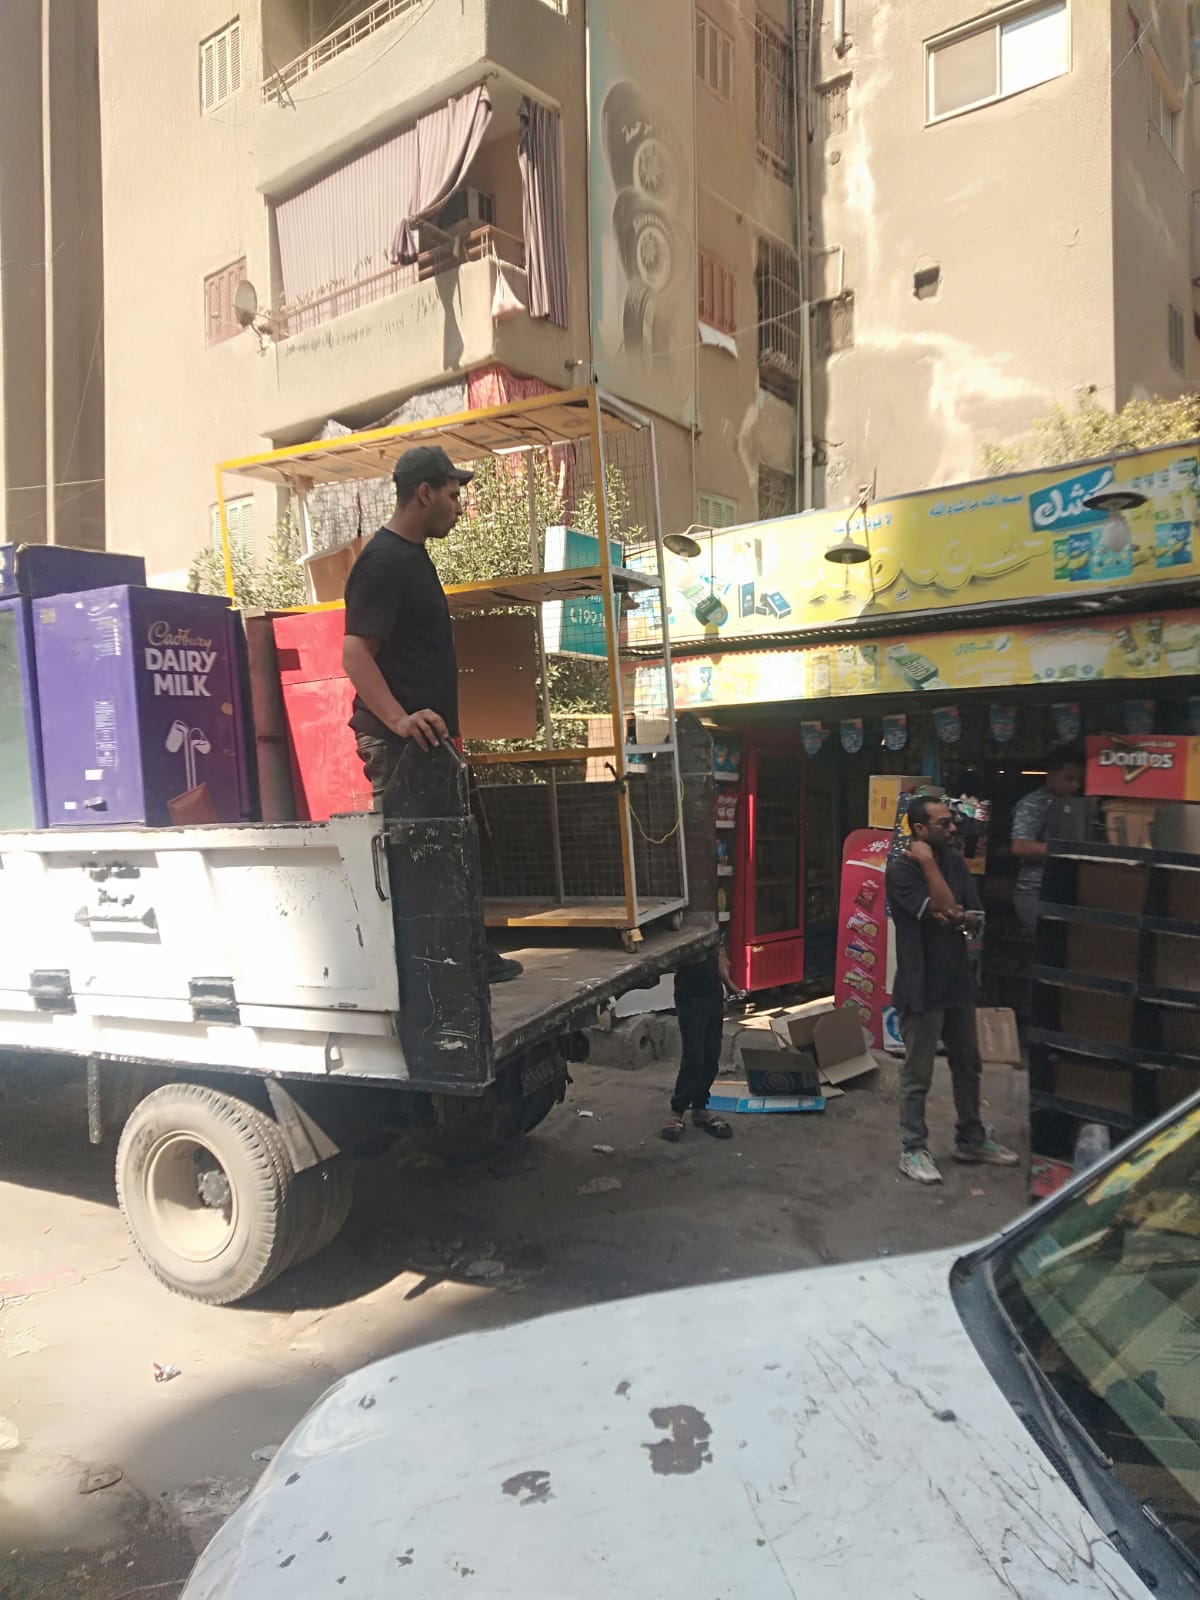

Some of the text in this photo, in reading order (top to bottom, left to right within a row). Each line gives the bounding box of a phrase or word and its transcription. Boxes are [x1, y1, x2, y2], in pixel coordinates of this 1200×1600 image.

[147, 620, 213, 653] Cadbury
[144, 647, 217, 673] DAIRY
[153, 673, 213, 697] MILK
[1099, 749, 1174, 768] Doritos
